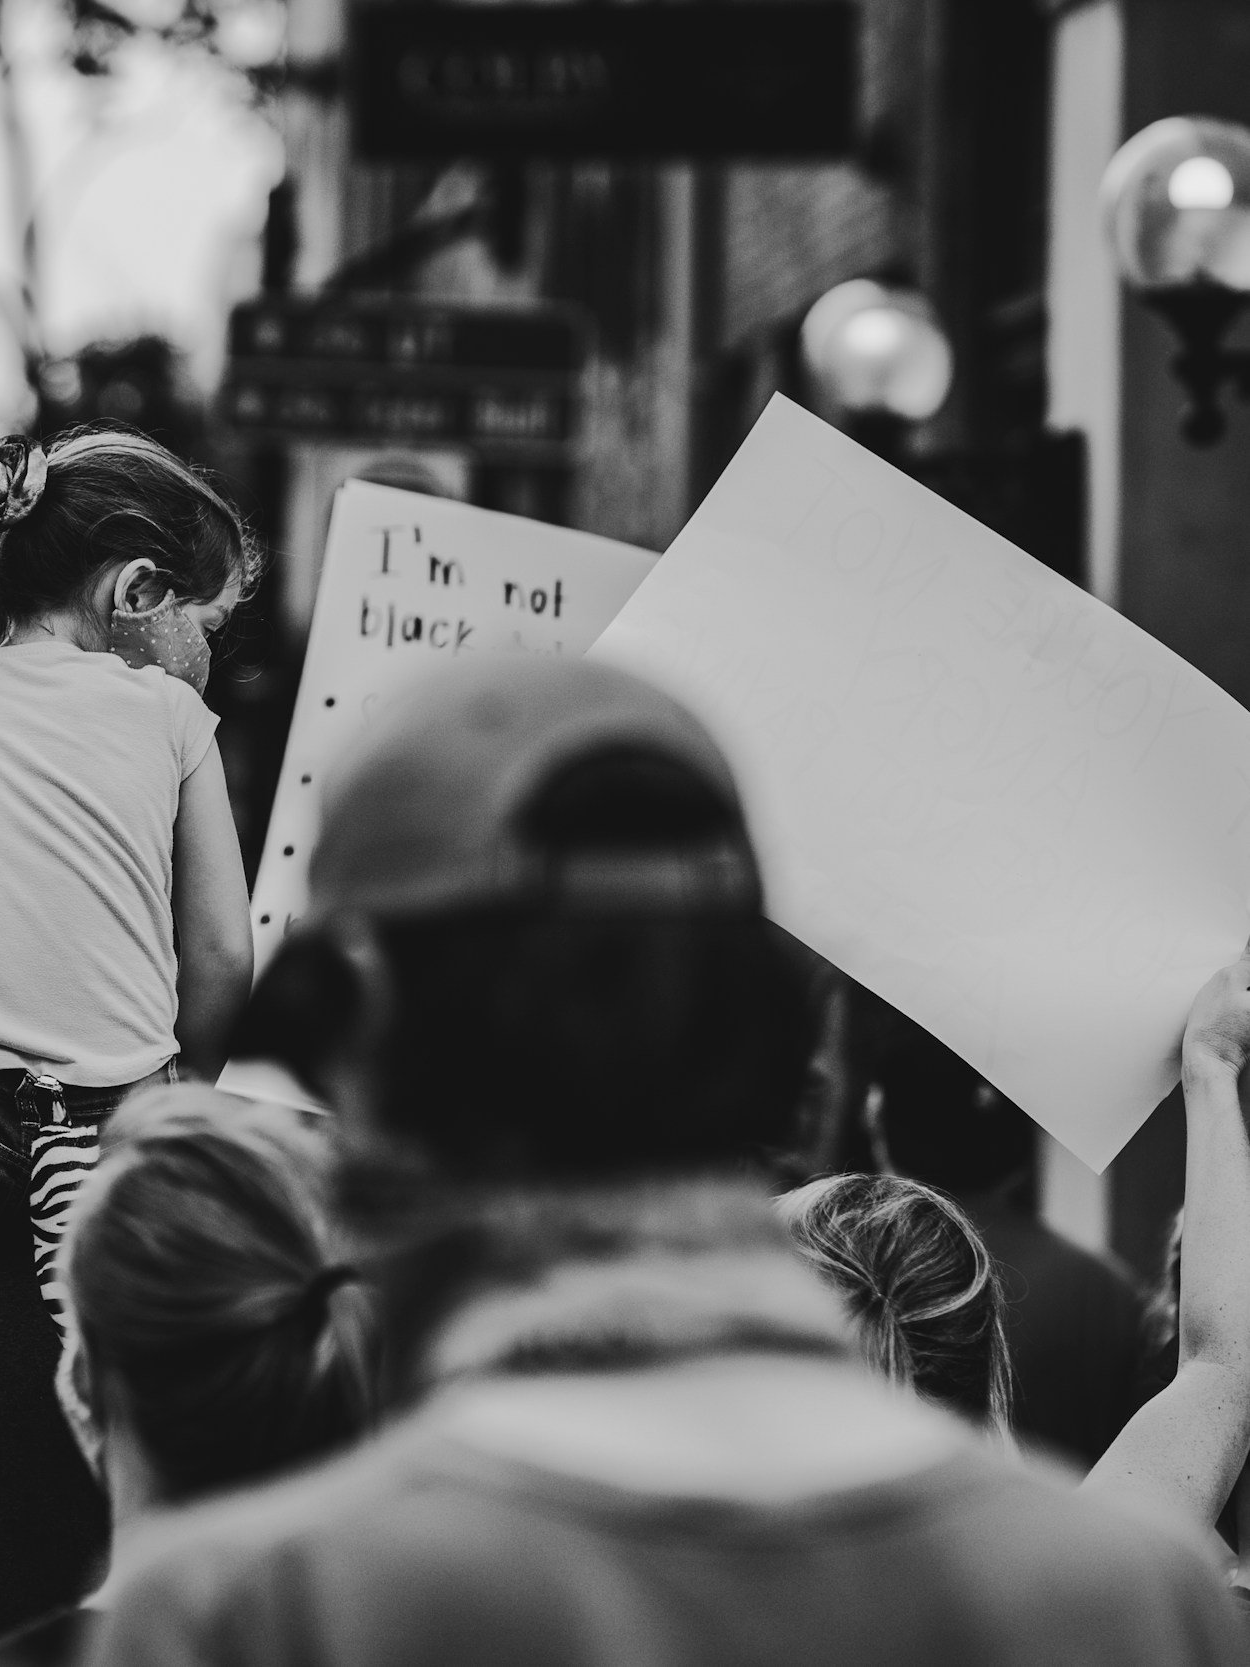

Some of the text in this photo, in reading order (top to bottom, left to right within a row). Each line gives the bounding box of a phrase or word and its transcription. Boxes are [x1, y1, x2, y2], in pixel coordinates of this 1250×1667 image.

[368, 523, 570, 618] I'm not
[359, 594, 475, 655] black
